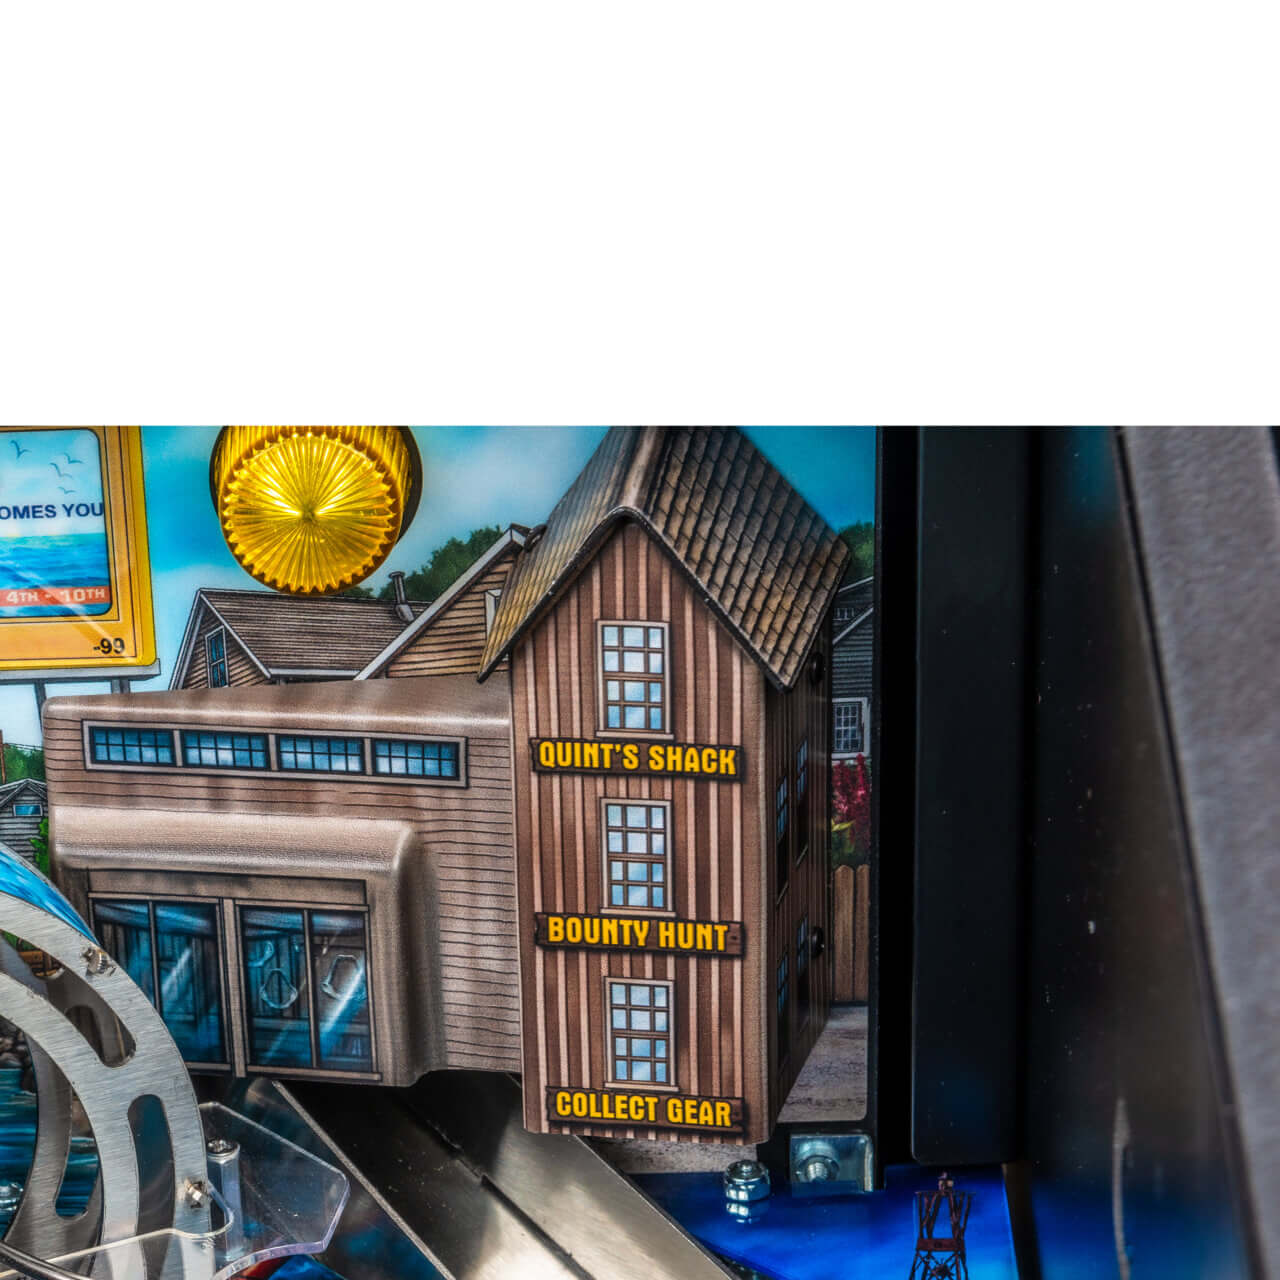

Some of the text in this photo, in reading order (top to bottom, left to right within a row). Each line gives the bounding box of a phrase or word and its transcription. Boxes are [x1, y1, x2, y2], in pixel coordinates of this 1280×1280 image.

[62, 501, 104, 518] YOU
[6, 589, 39, 605] 4TH
[59, 588, 106, 603] 10TH
[93, 636, 127, 654] -99
[539, 740, 737, 776] QUINT'S SHACK
[547, 916, 729, 952] BOUNTY HUNT
[556, 1091, 731, 1128] COLLECT GEAR
